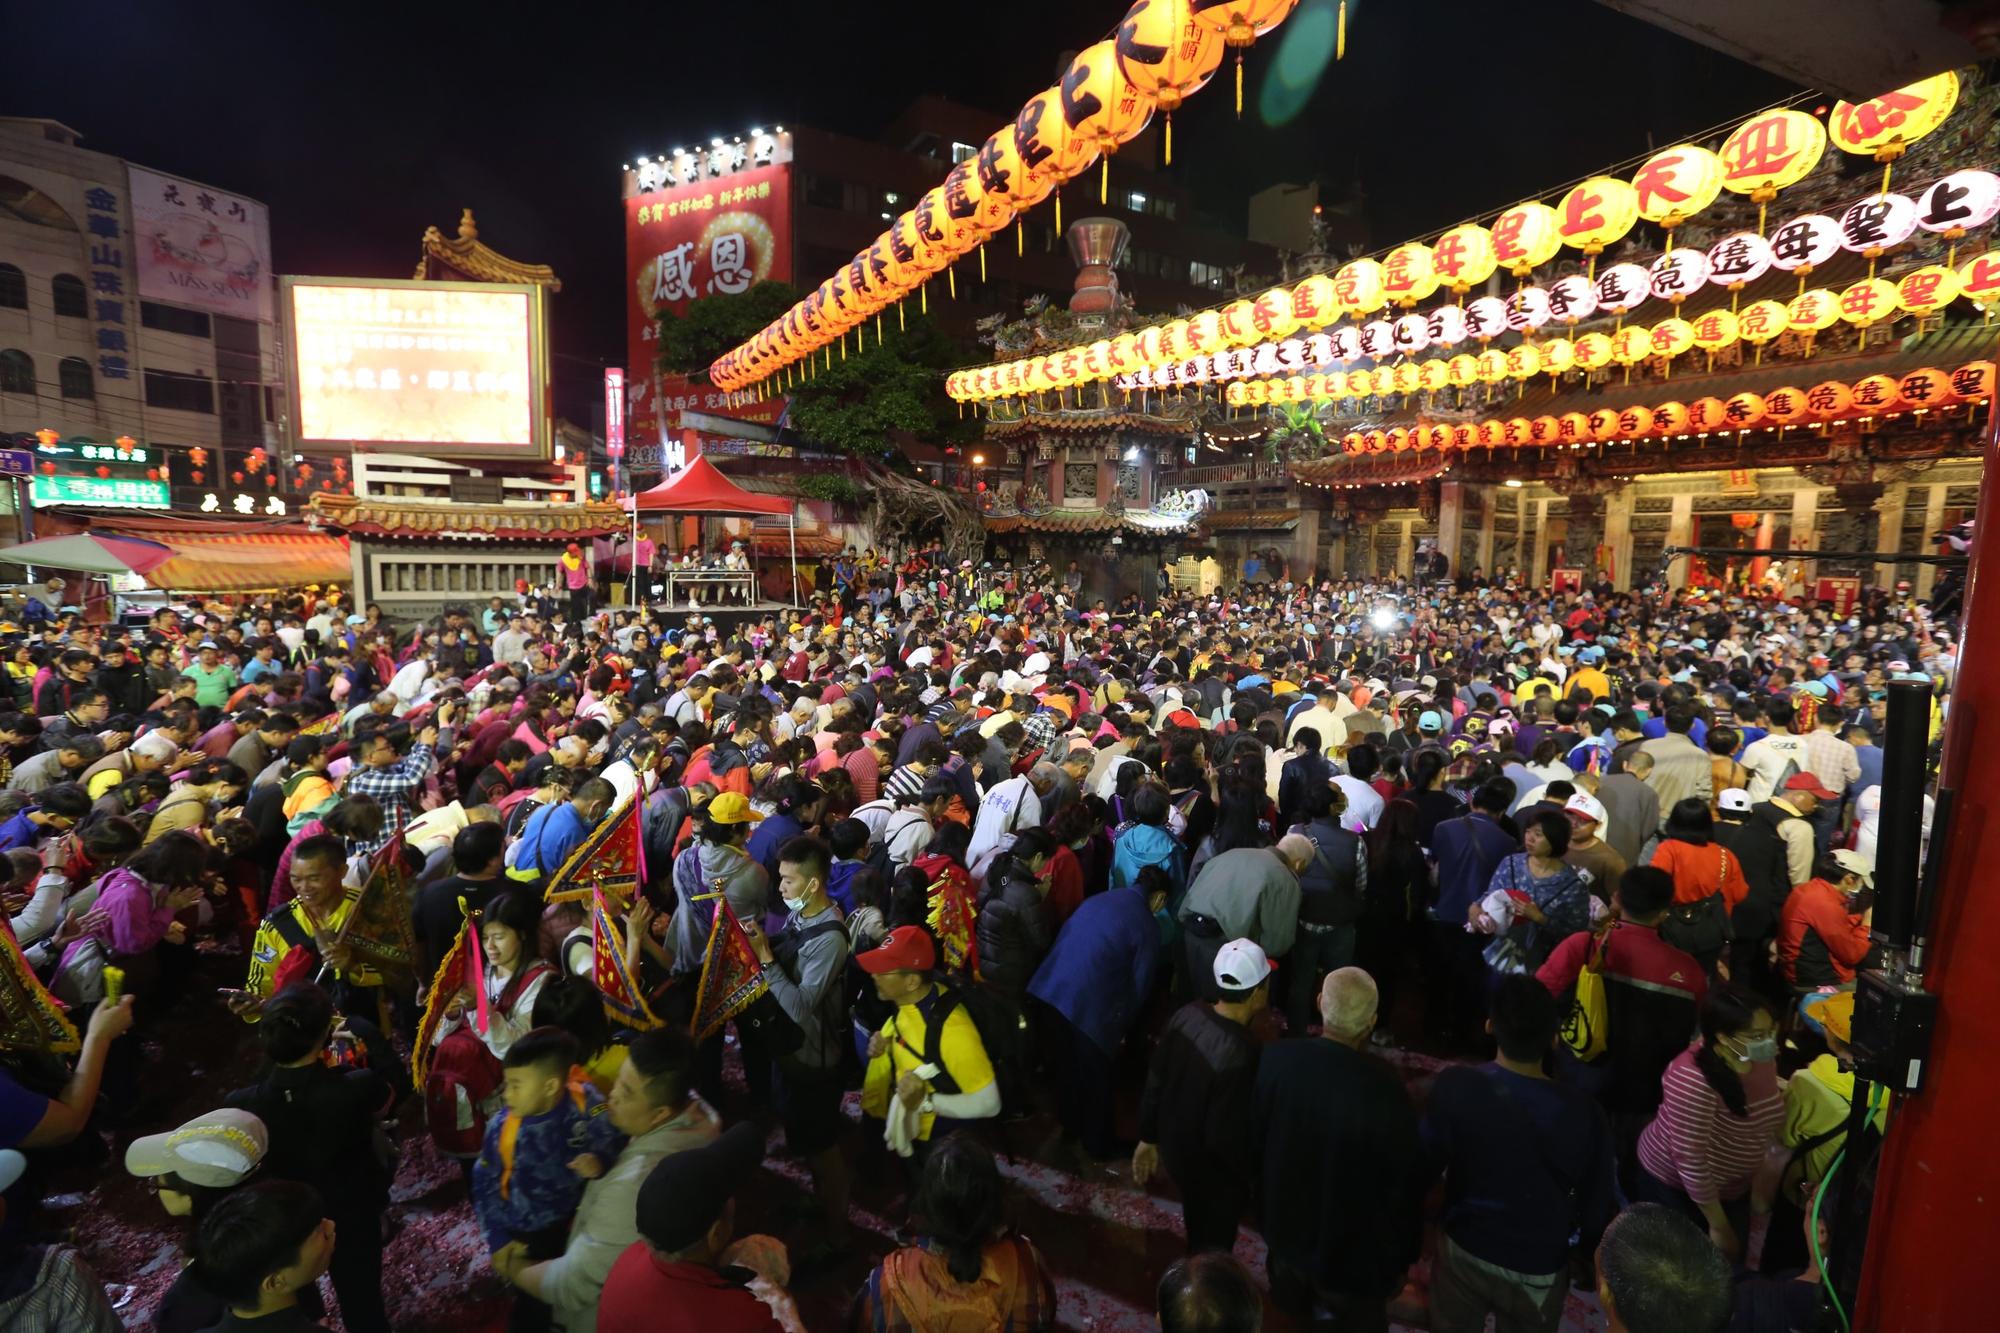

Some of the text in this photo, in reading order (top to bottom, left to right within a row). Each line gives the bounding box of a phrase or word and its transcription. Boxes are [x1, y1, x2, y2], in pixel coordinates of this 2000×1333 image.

[1722, 116, 1799, 180] 迎
[719, 182, 770, 206] 新年快樂
[1631, 156, 1693, 214] 天
[1558, 188, 1604, 238] 上
[1921, 183, 1973, 225] 上
[1490, 212, 1527, 263] 聖
[1842, 201, 1893, 247] 聖
[1431, 234, 1467, 278] 母
[1709, 237, 1758, 276] 遶
[1771, 222, 1820, 261] 母
[652, 232, 753, 302] 感恩
[1963, 259, 2000, 293] 上
[1548, 282, 1579, 316] 香
[1596, 271, 1633, 304] 進
[1840, 284, 1879, 316] 母
[1899, 274, 1943, 308] 聖
[1464, 303, 1489, 334] 香
[1695, 317, 1726, 342] 進
[1573, 338, 1597, 363] 香
[1651, 325, 1679, 351] 香
[1900, 376, 1935, 401] 母
[1952, 368, 1985, 396] 聖
[1725, 399, 1753, 422] 香
[1766, 393, 1796, 415] 進
[1808, 387, 1839, 410] 境
[1589, 414, 1606, 434] 中
[1619, 413, 1639, 432] 台
[1653, 408, 1675, 429] 香
